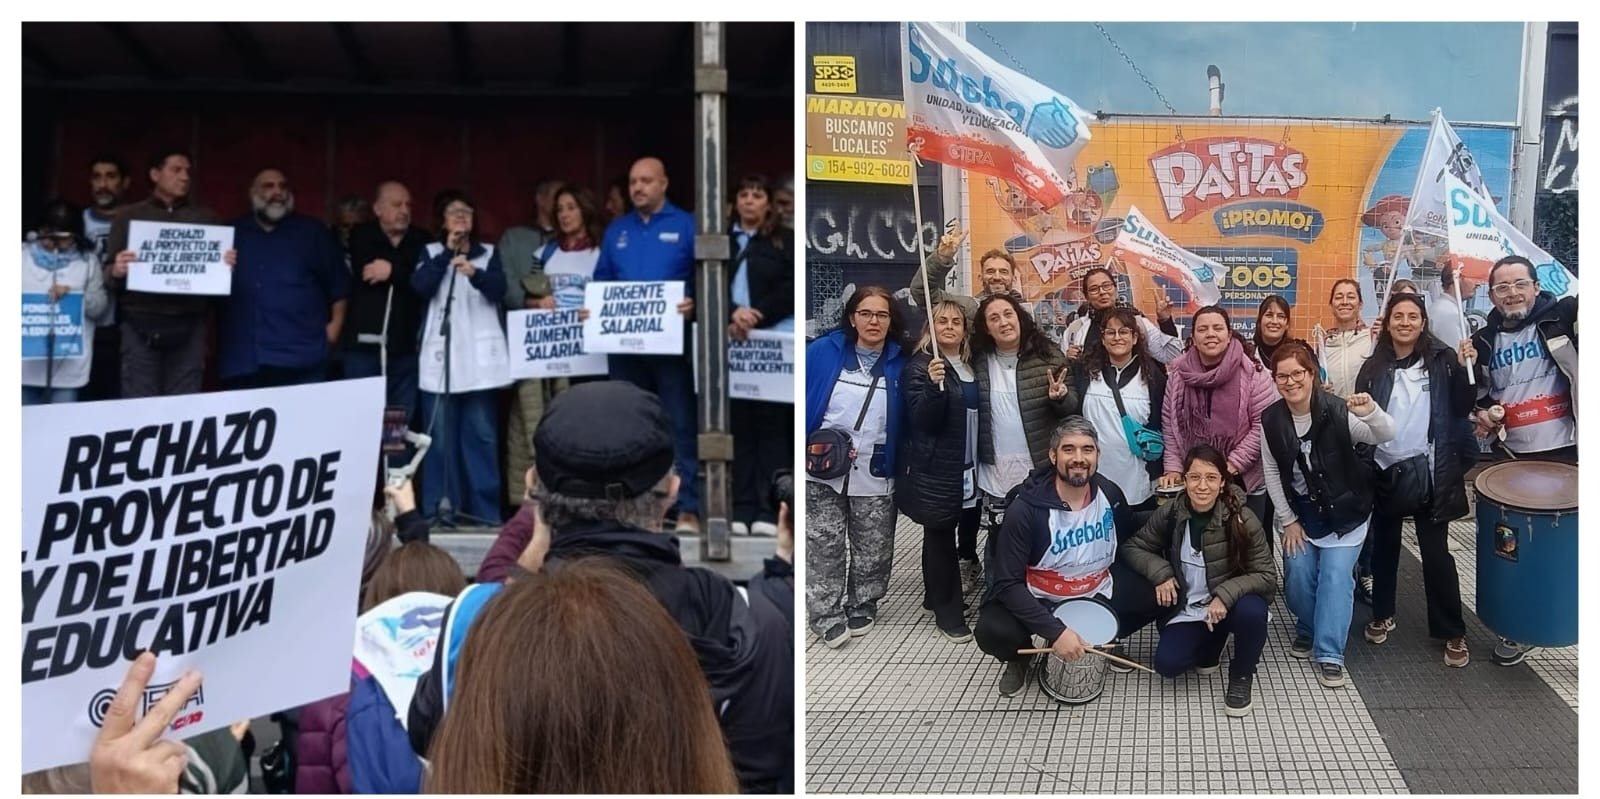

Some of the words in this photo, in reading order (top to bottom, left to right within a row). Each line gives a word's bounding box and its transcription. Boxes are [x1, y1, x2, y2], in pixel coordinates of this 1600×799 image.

[816, 66, 840, 79] SPS
[808, 98, 905, 118] MARATON
[926, 94, 964, 114] UNIDAD,
[825, 118, 894, 137] BUSCAMOS
[826, 136, 893, 155] "LOCALES"
[827, 160, 910, 178] 154-992-6020
[1222, 210, 1313, 231] ¡PROMO!
[159, 229, 205, 239] RECHAZO
[141, 240, 154, 250] AL
[154, 240, 207, 251] PROYECTO
[208, 241, 221, 251] DE
[140, 252, 158, 262] LEY
[161, 252, 174, 262] DE
[174, 252, 221, 262] LIBERTAD
[152, 264, 206, 274] EDUCATIVA
[603, 283, 665, 301] URGENTE
[600, 300, 666, 318] AUMENTO
[600, 318, 665, 334] SALARIAL
[730, 350, 783, 360] PARITARIA
[749, 362, 794, 373] DOCENTE
[59, 407, 276, 494] RECHAZO
[36, 464, 284, 561] PROYECTO
[286, 450, 341, 511] DE
[56, 553, 133, 618] DE
[133, 507, 335, 605] LIBERTAD
[22, 578, 274, 684] EDUCATIVA
